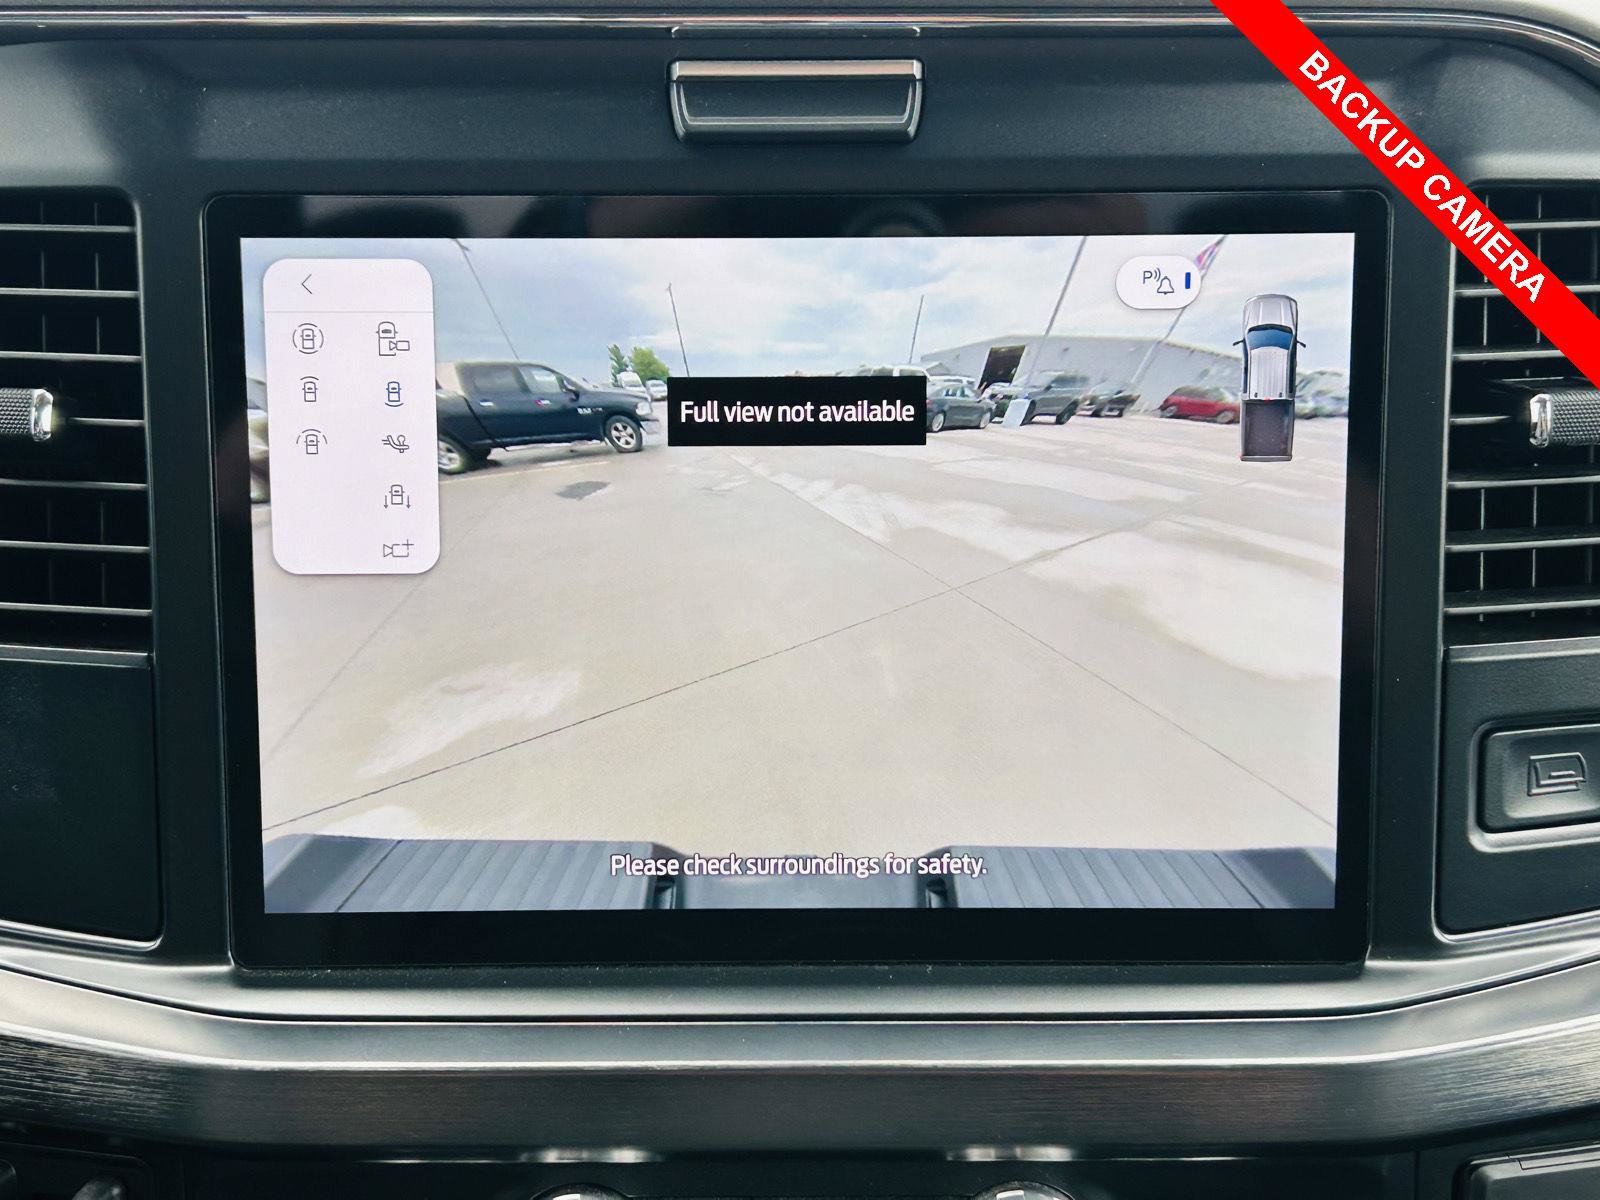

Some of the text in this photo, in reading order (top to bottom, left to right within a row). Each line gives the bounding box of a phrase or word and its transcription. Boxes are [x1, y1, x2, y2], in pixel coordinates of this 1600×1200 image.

[680, 399, 915, 423] Full view not available
[610, 852, 988, 879] Please check surroundings for safety.
